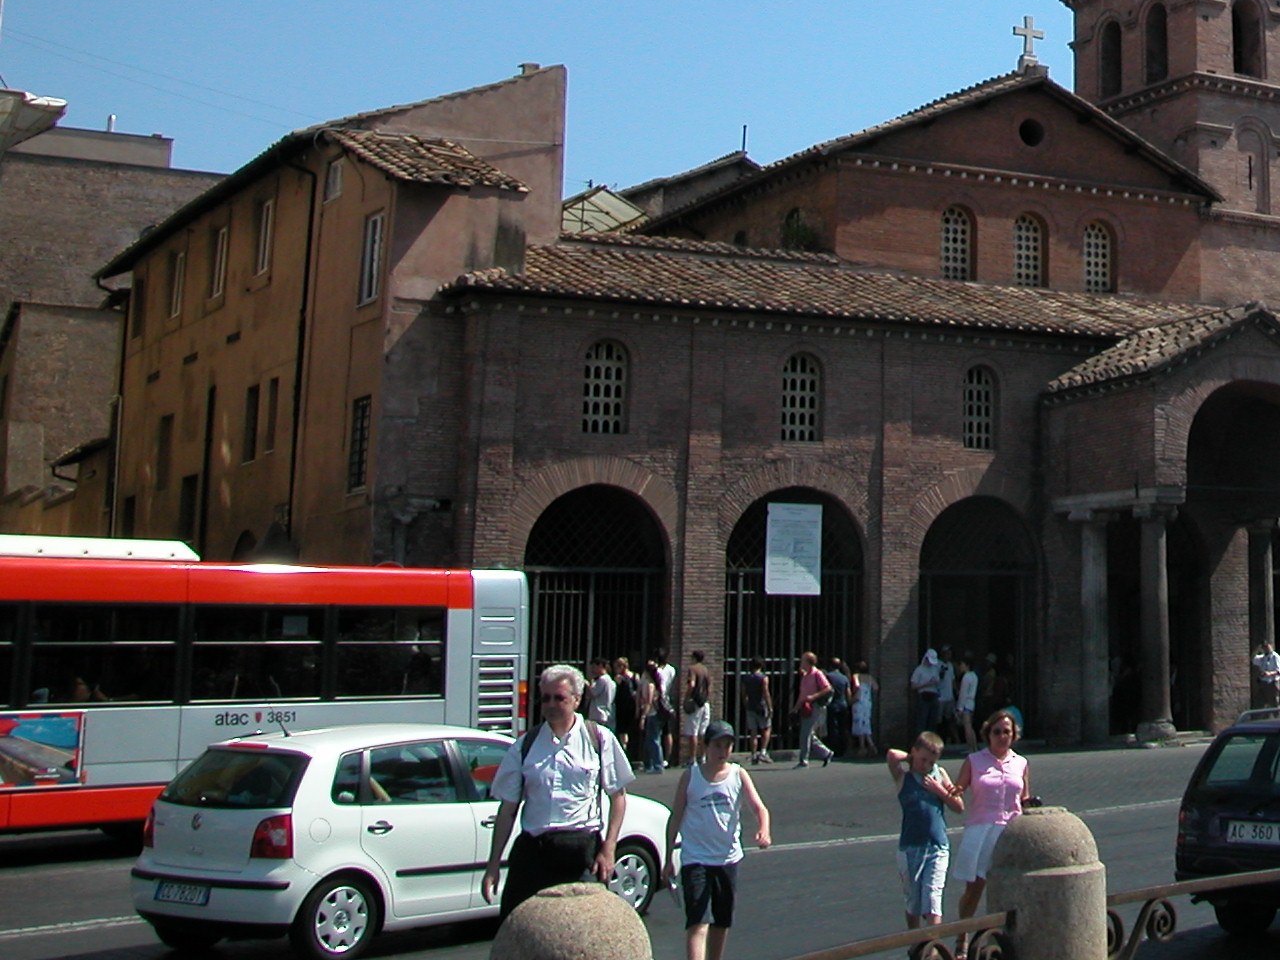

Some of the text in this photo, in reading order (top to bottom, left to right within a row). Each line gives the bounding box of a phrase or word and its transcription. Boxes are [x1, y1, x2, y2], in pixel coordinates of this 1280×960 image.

[215, 711, 249, 726] atac
[1230, 823, 1245, 838] AC
[1251, 824, 1273, 840] 360
